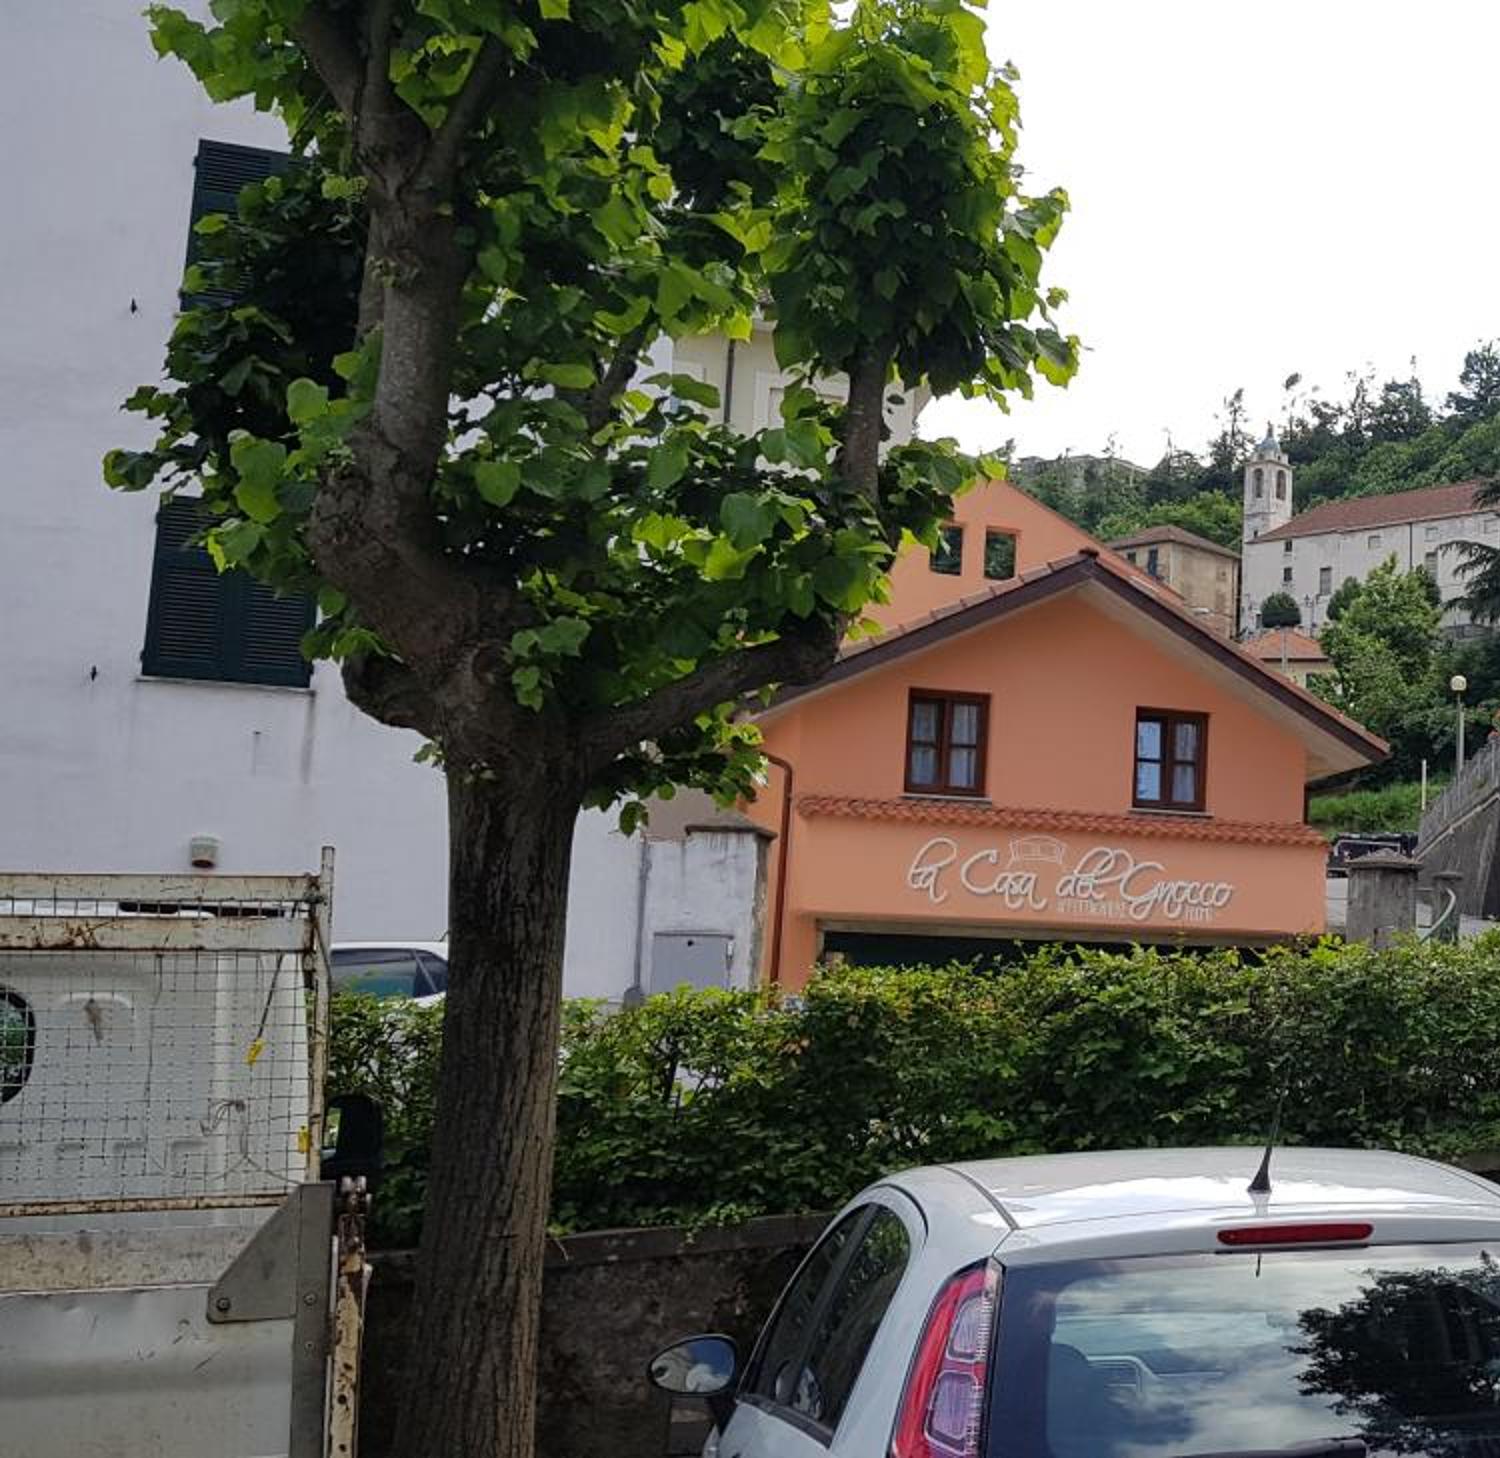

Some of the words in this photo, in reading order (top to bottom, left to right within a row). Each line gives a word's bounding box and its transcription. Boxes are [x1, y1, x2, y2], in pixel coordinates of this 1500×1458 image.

[960, 849, 1051, 910] Casa
[1056, 847, 1134, 902] del
[1119, 861, 1235, 921] Gnocco
